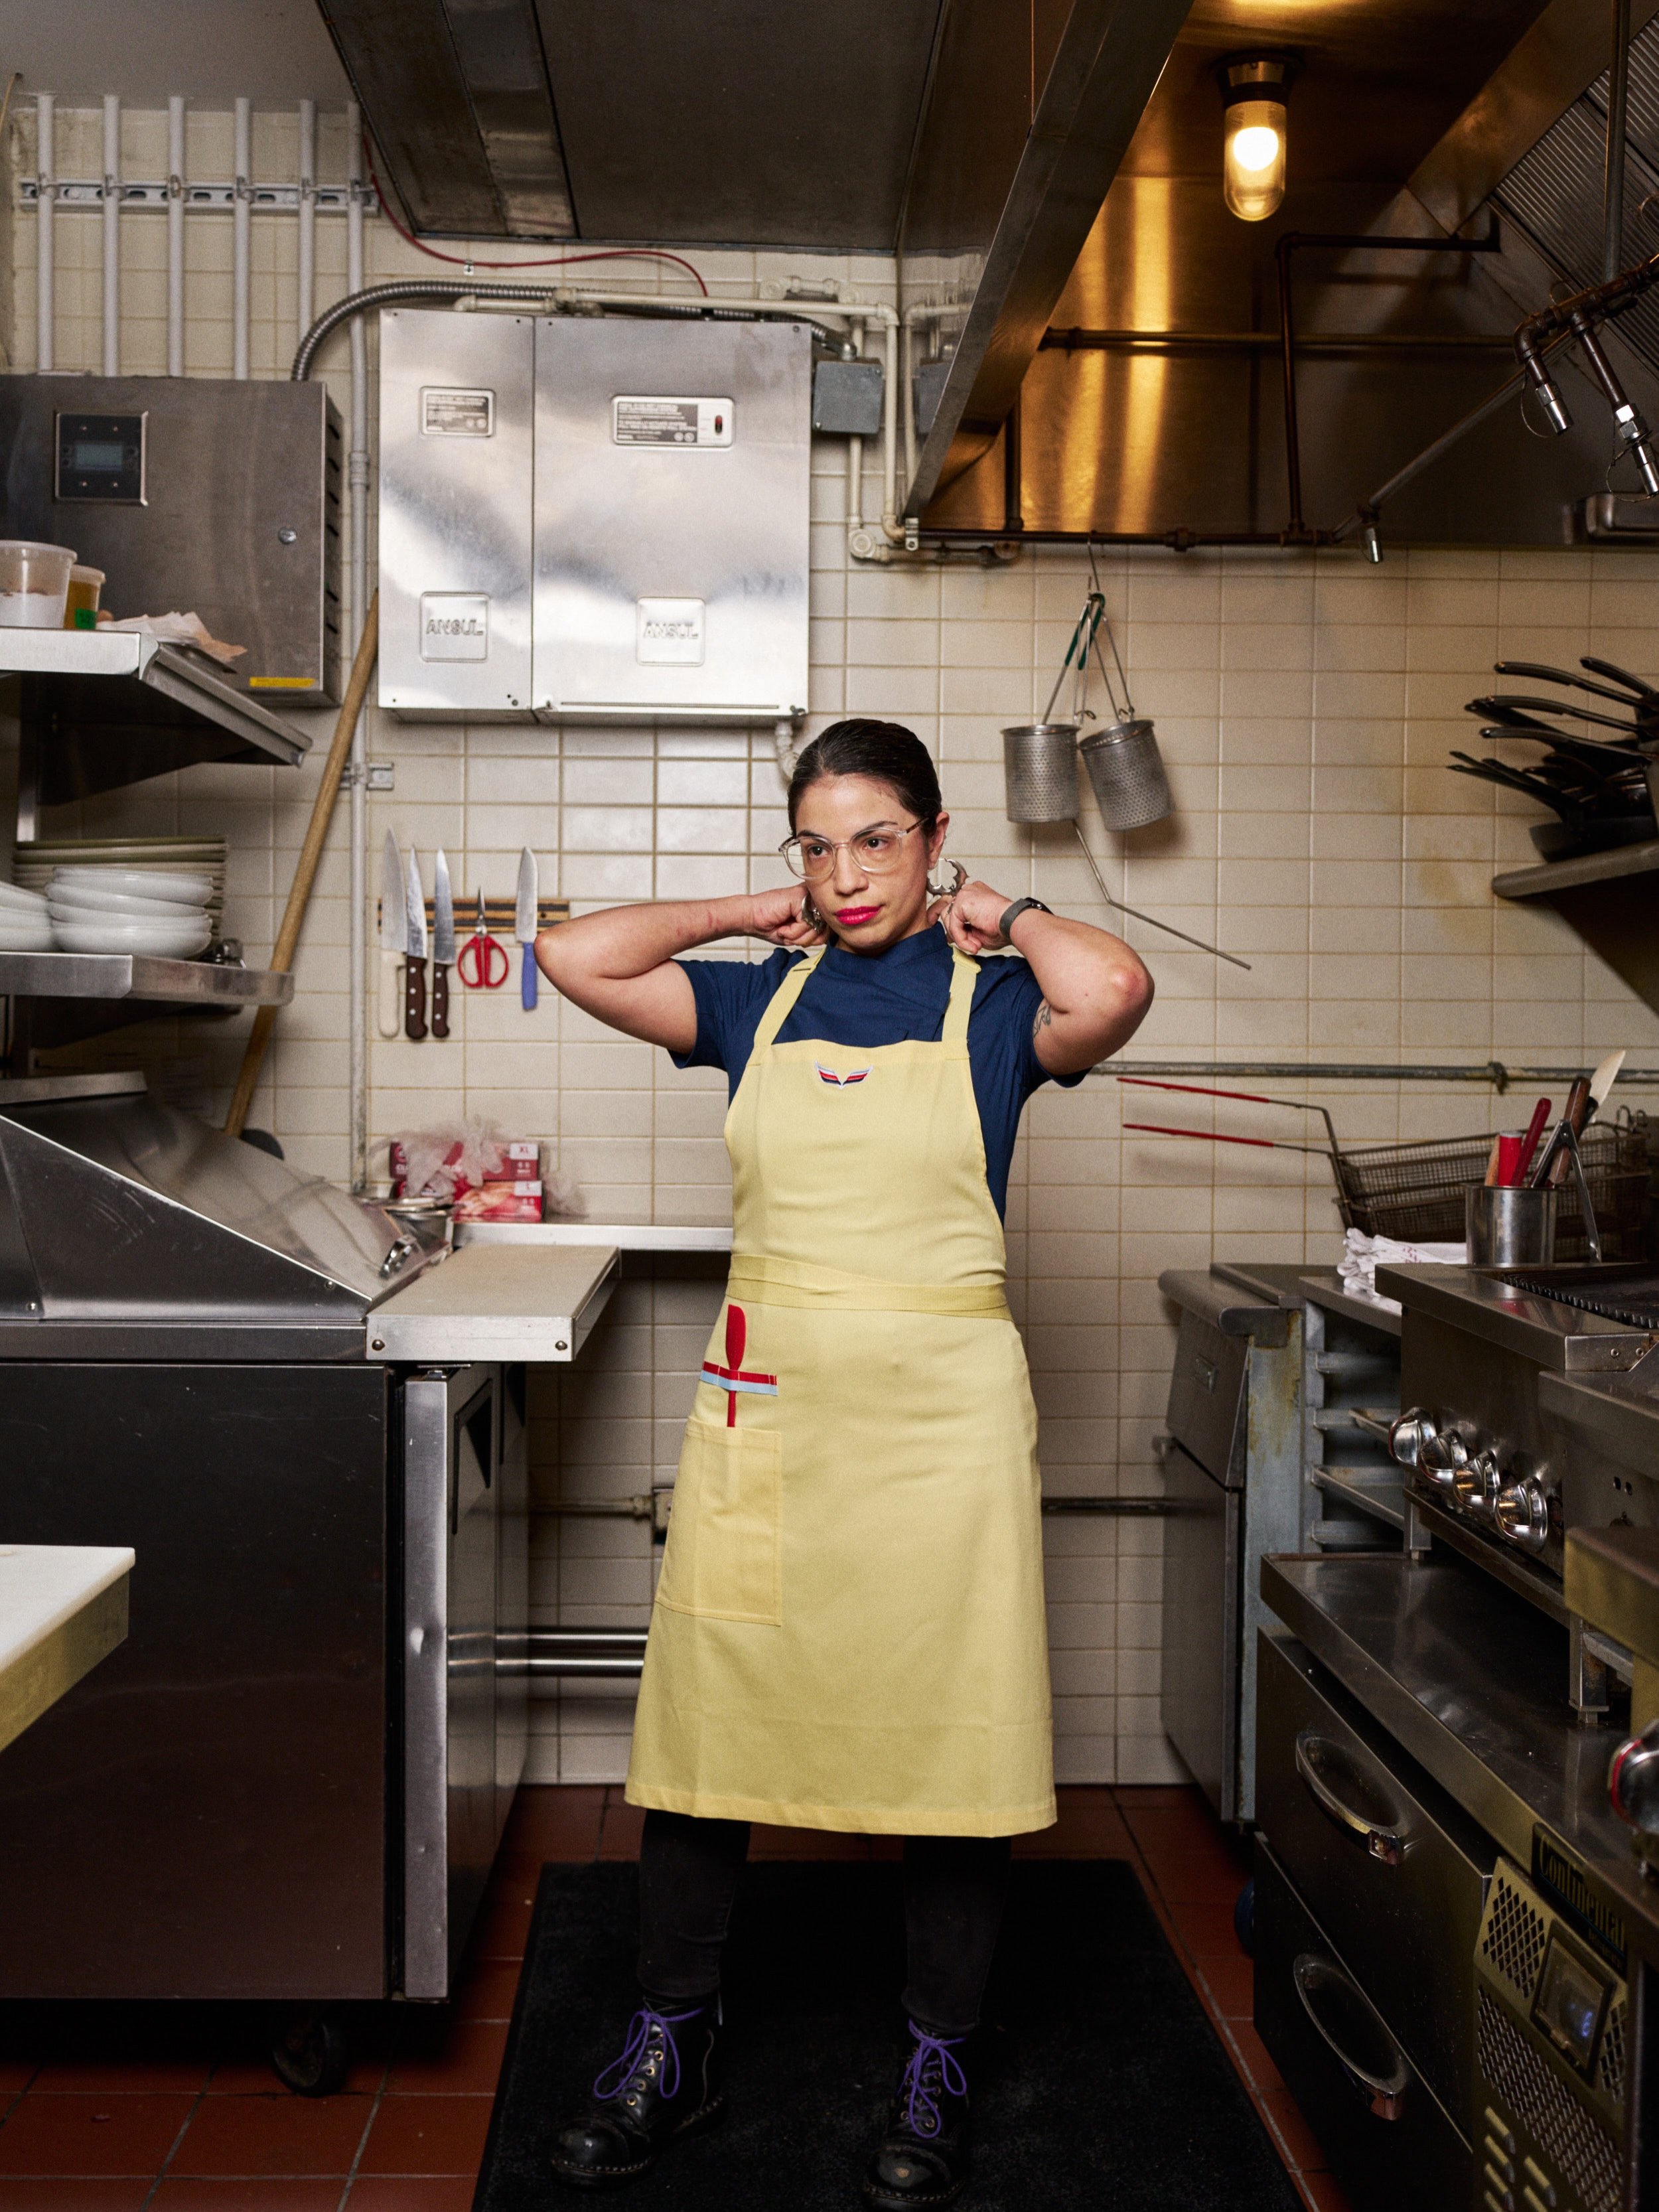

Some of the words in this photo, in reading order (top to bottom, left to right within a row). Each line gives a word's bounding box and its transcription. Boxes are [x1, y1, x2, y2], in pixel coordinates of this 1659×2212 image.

[426, 618, 483, 636] ANSUL
[643, 621, 699, 639] ANSUL
[1539, 1834, 1625, 1953] Continental
